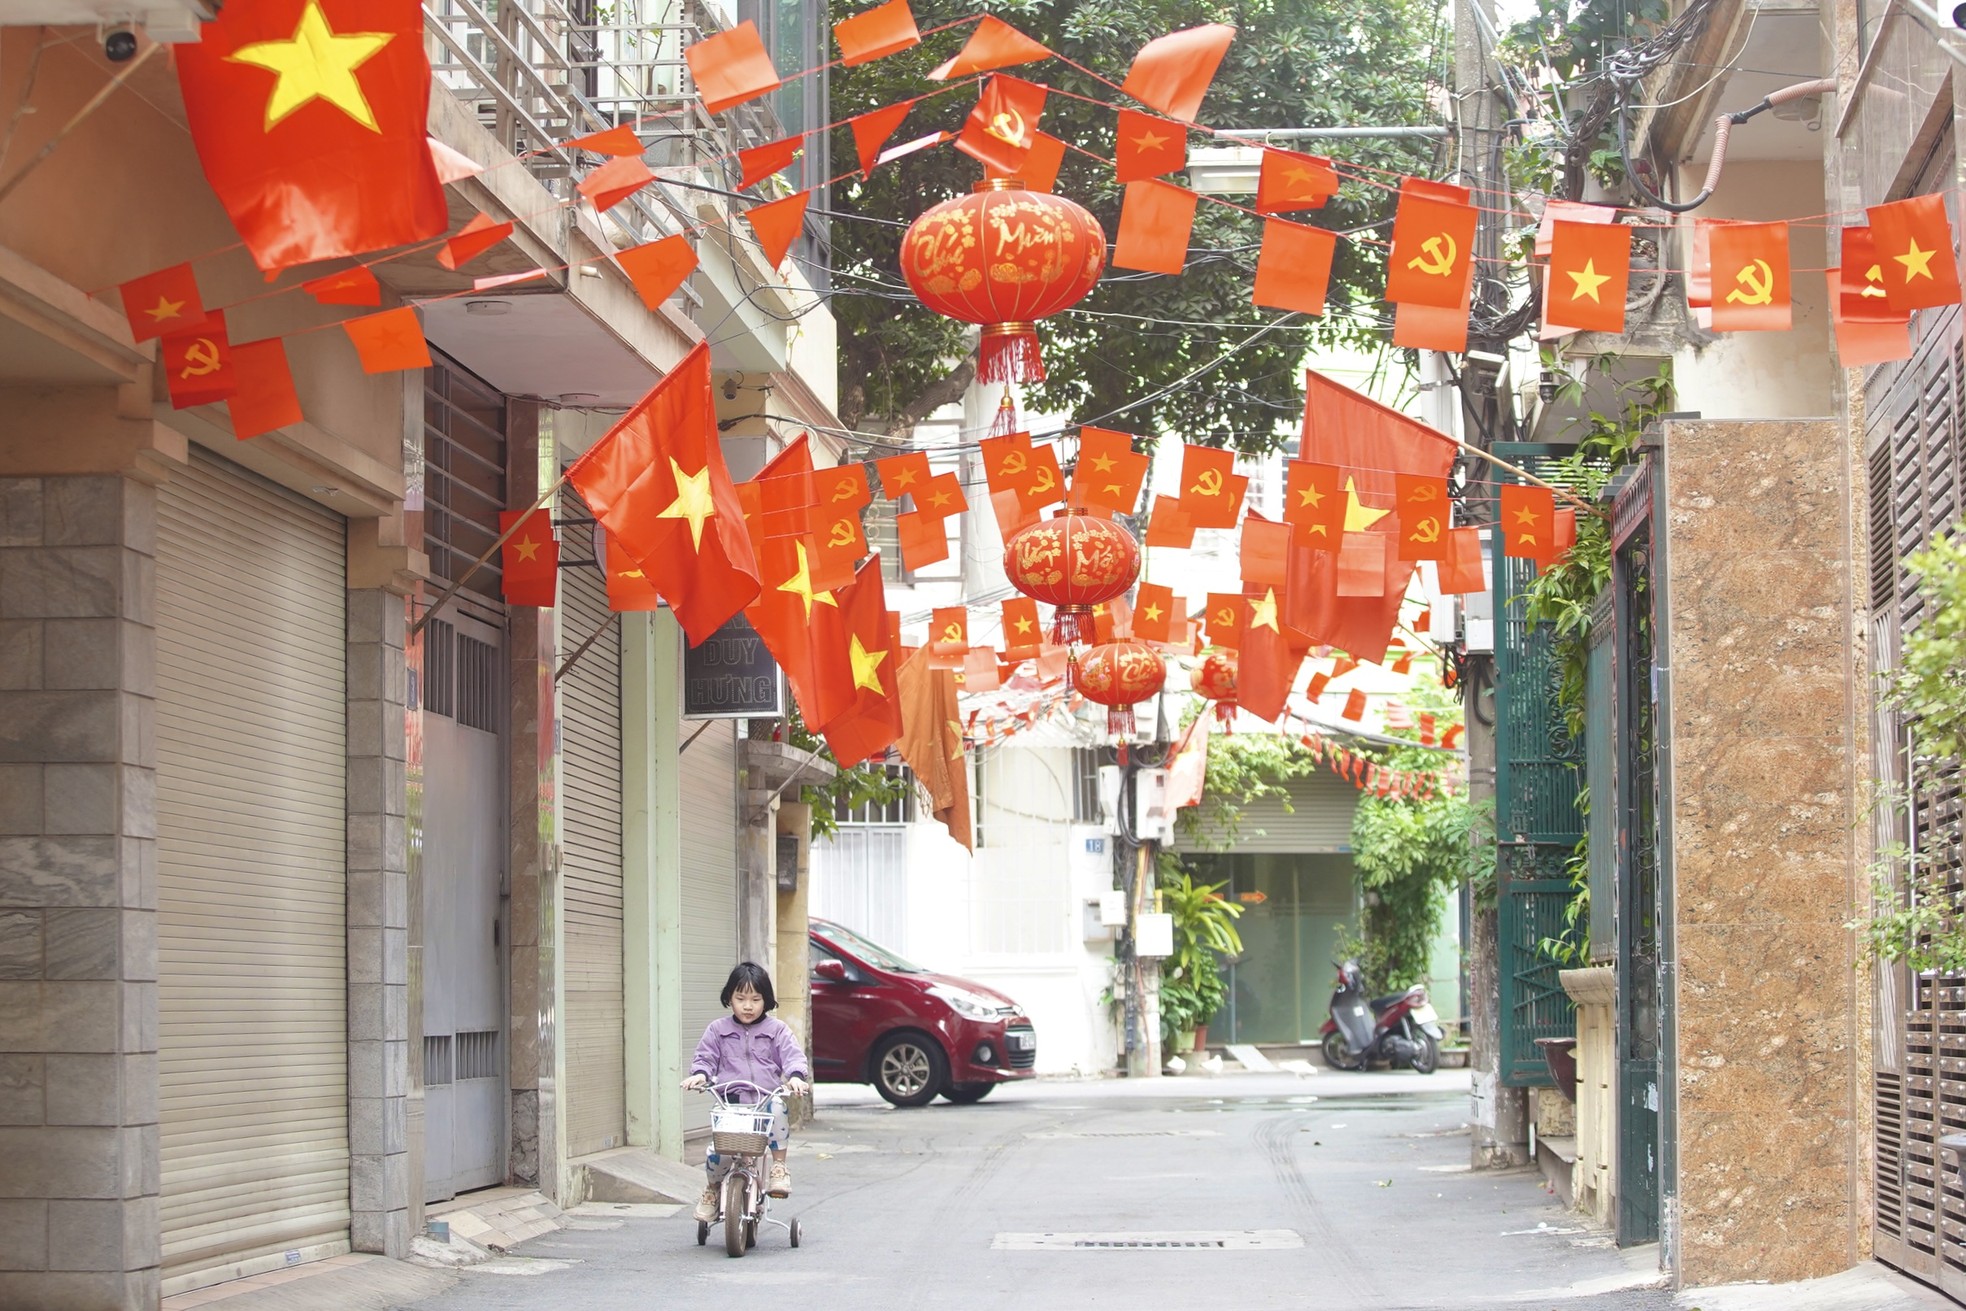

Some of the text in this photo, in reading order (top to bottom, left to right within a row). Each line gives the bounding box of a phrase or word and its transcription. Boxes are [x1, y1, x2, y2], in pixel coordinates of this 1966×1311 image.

[703, 637, 759, 666] DUY
[690, 673, 772, 705] HƯNG
[1089, 839, 1102, 852] 18
